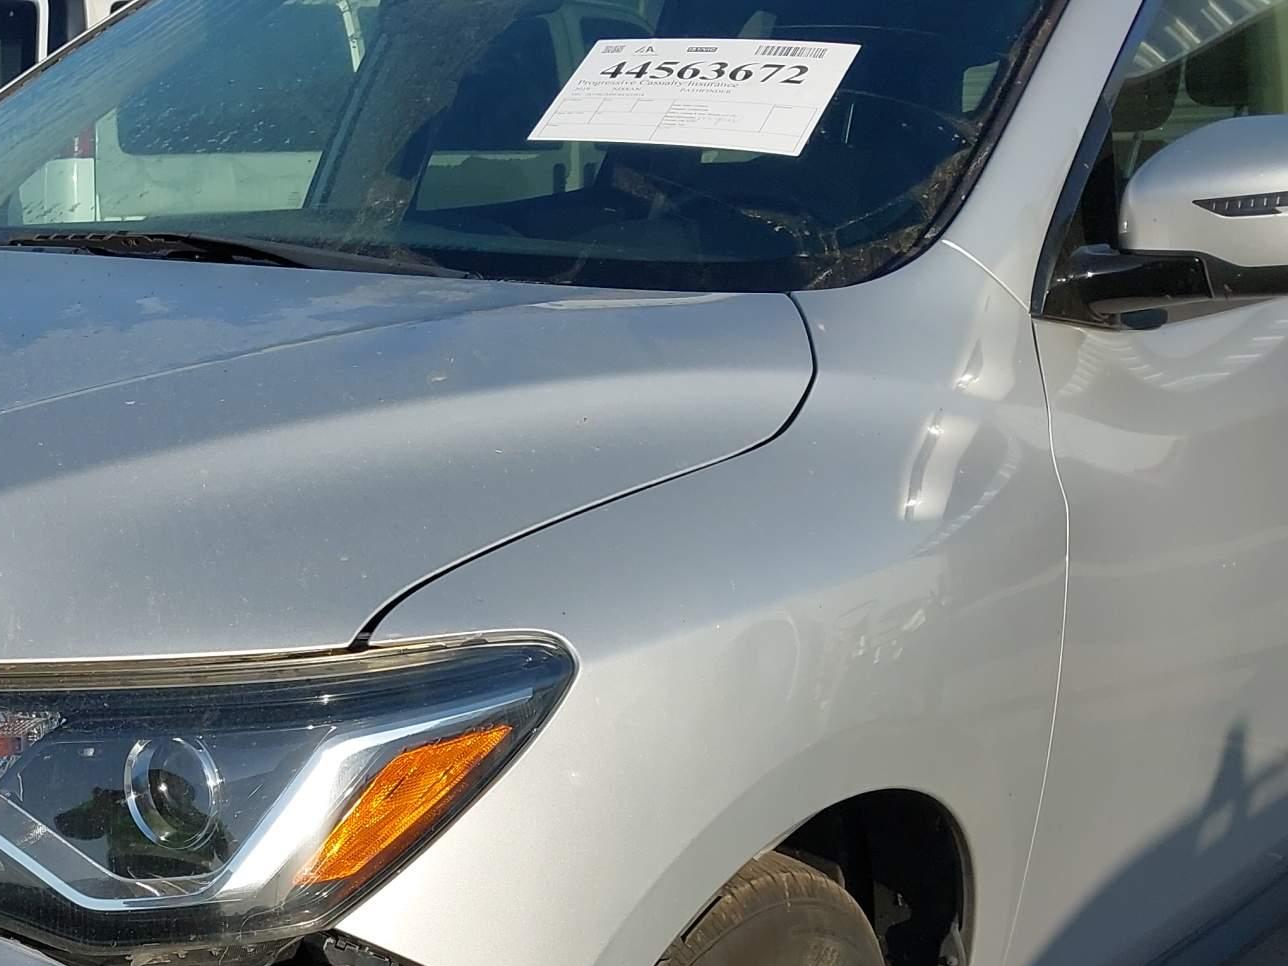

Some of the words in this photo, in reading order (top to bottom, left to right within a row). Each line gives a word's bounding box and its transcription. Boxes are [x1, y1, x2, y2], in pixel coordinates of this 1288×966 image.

[600, 61, 809, 85] 44563672
[577, 79, 638, 88] Progressive
[639, 80, 682, 88] Casualty
[687, 80, 740, 88] Insurance
